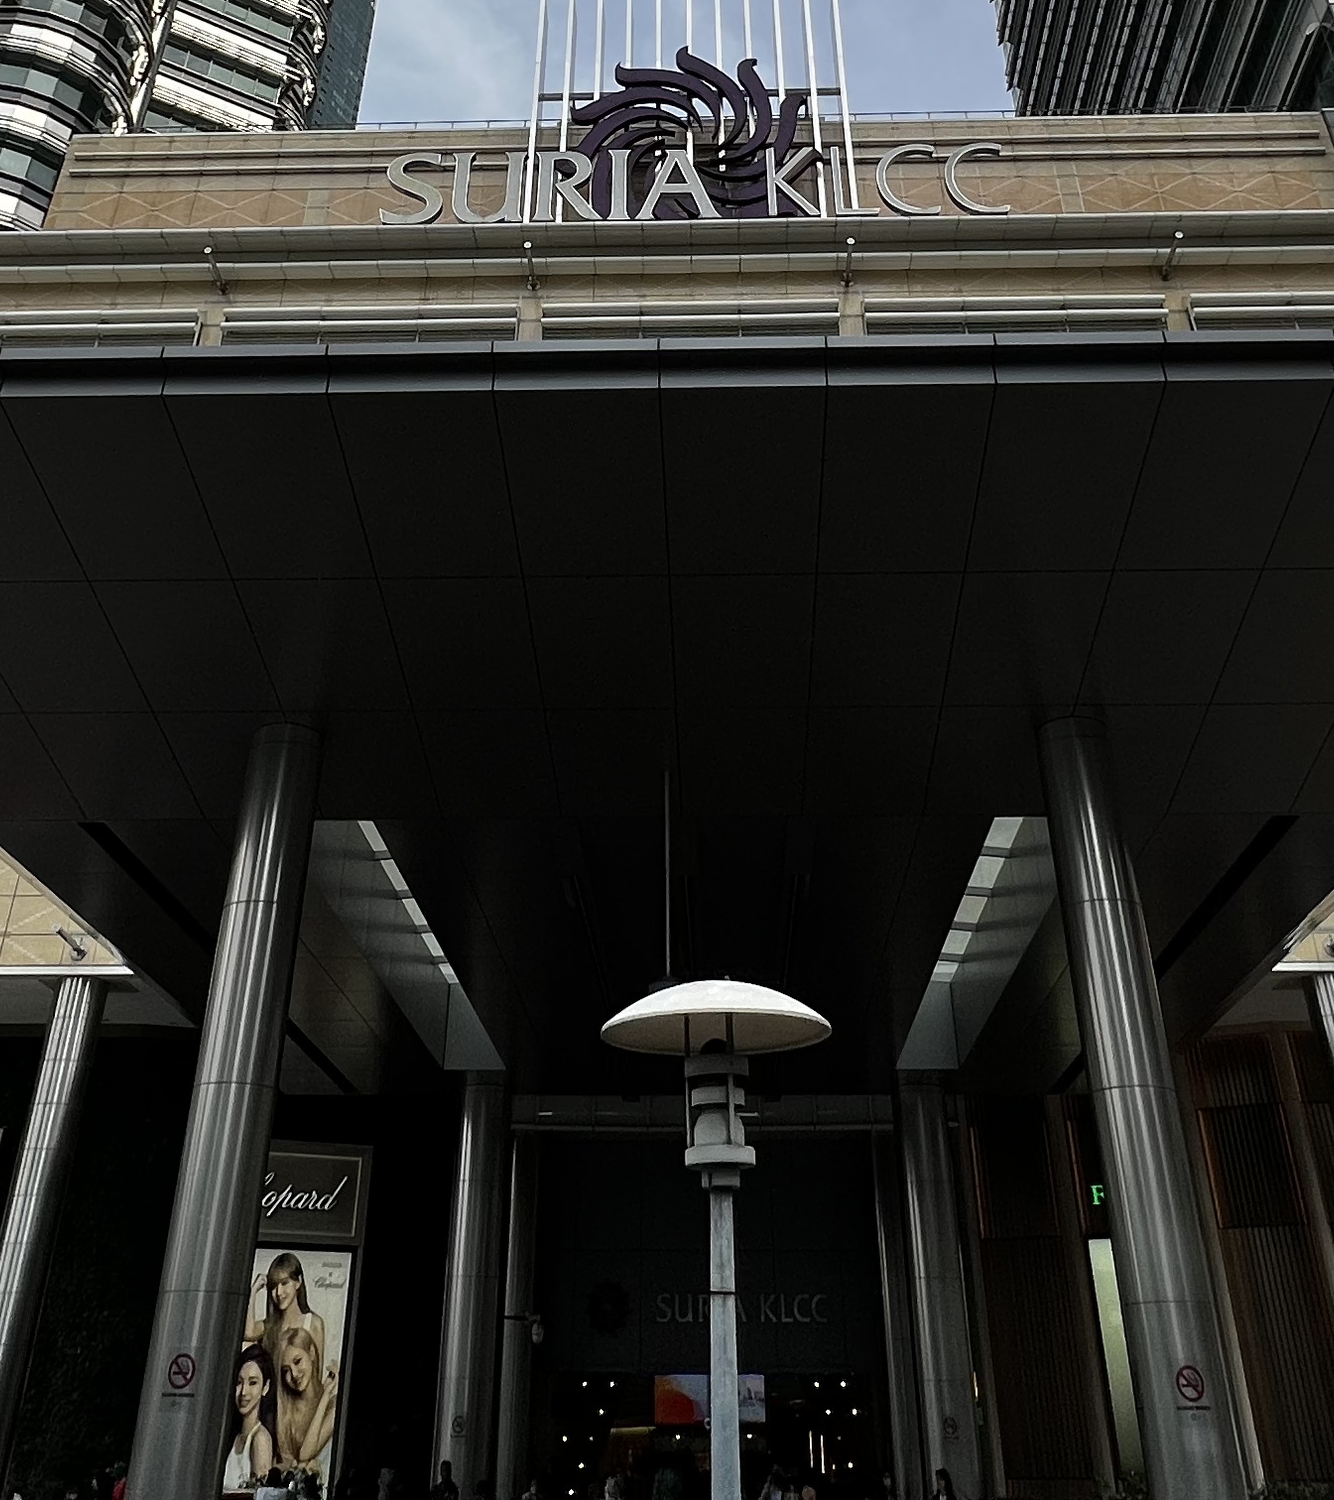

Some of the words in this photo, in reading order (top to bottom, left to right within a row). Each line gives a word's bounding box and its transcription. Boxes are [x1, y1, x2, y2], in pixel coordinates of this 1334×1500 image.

[378, 150, 723, 225] SURIA
[764, 142, 1011, 217] KLCC
[261, 1171, 349, 1217] opard
[656, 1293, 747, 1323] SUR
[760, 1293, 828, 1323] KLCC
